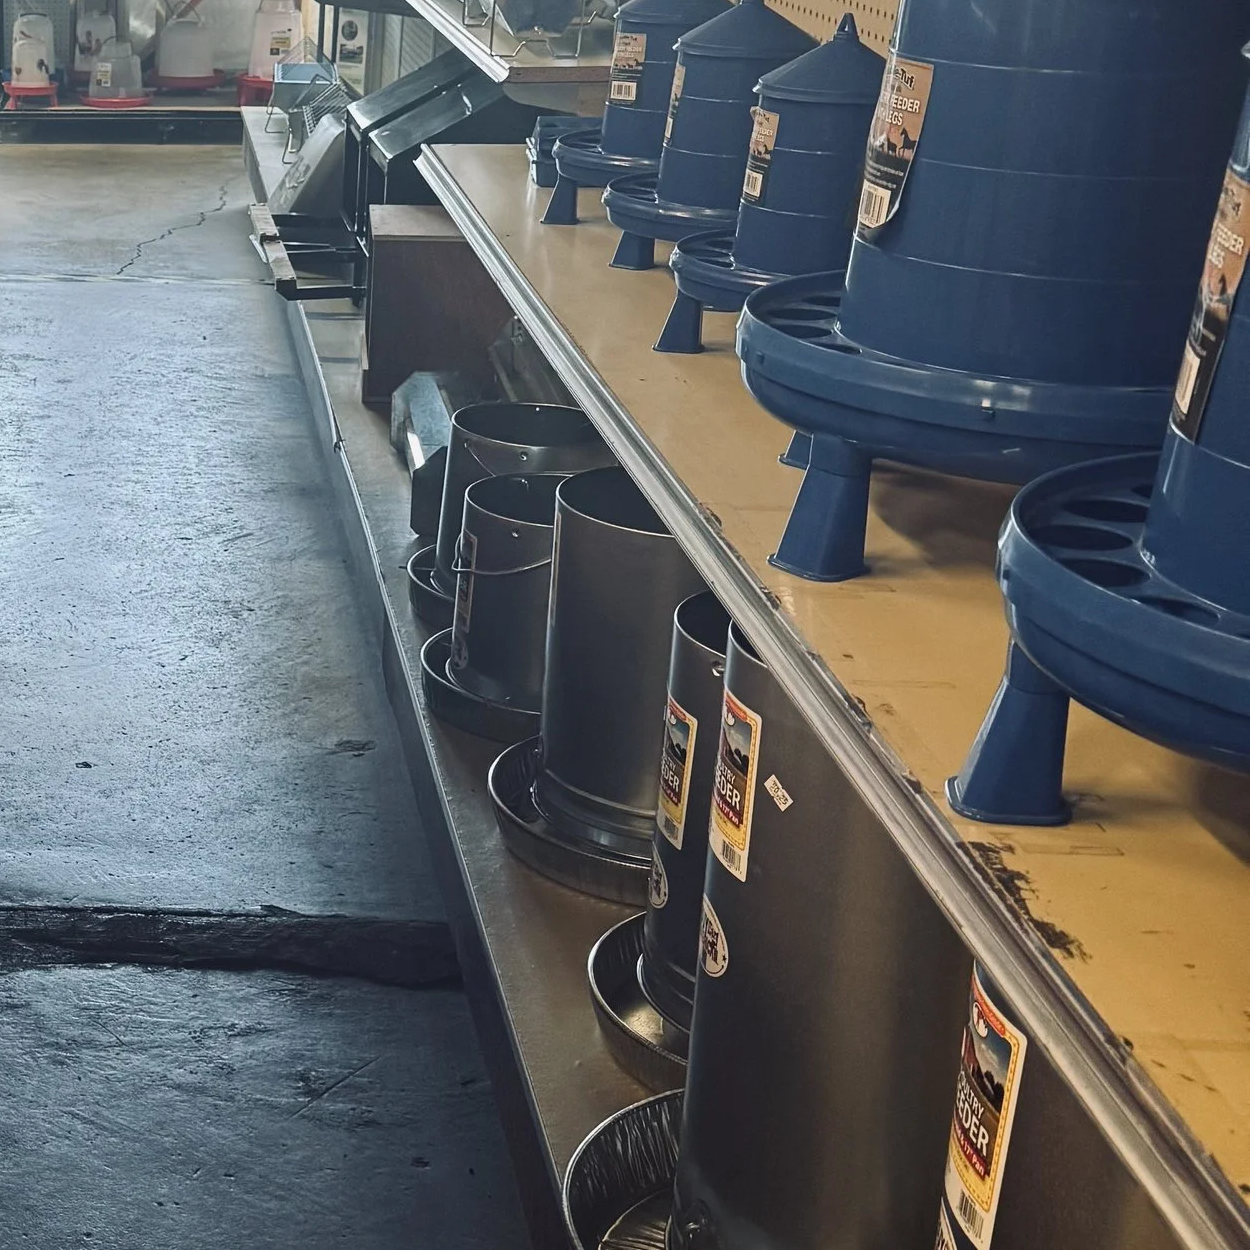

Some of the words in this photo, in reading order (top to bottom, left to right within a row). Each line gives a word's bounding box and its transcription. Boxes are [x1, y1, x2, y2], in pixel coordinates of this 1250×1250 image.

[886, 110, 904, 127] LEGS
[661, 764, 680, 793] EDER
[716, 773, 741, 811] EDER
[957, 1070, 985, 1119] OULTRY
[957, 1090, 990, 1157] EEDER
[972, 1153, 985, 1176] Pan
